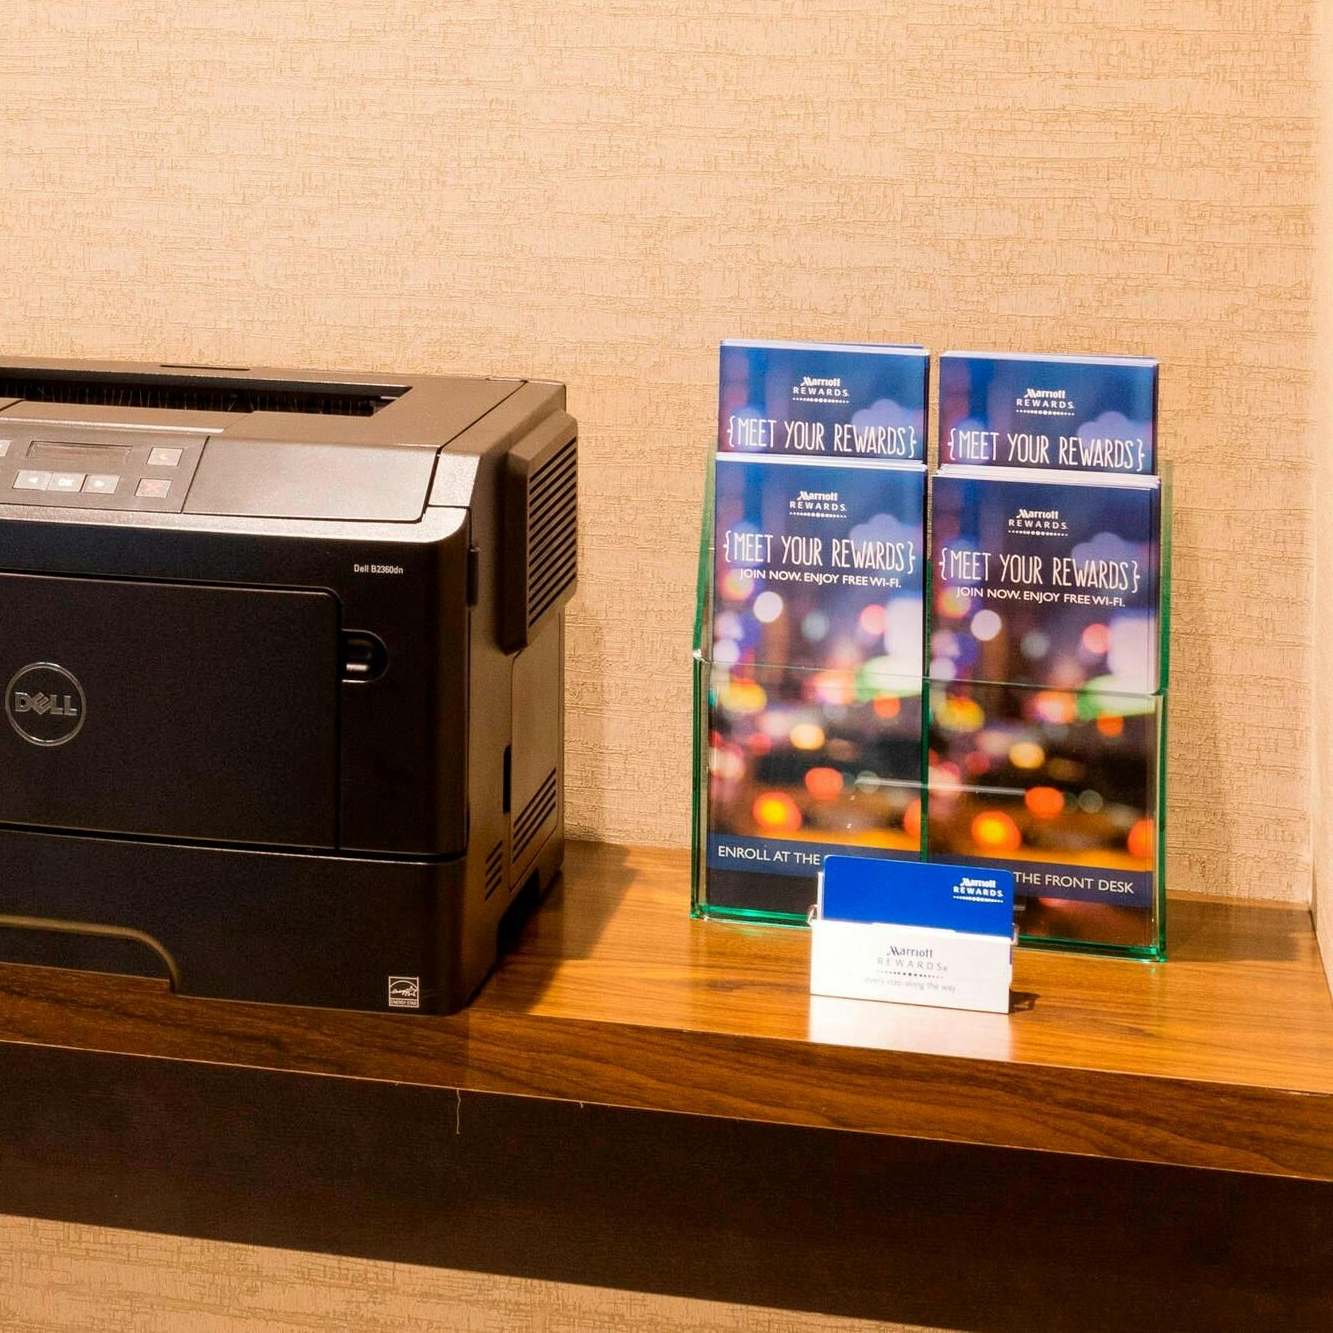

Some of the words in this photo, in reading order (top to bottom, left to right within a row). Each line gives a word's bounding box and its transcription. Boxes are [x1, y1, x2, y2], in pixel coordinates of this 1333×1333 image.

[800, 376, 841, 387] Marriott
[793, 386, 849, 397] REWARDS
[1024, 388, 1066, 399] Marriott
[1016, 398, 1075, 409] REWARDS
[784, 420, 825, 451] YOUR
[1007, 433, 1050, 464] YOUR
[58, 478, 73, 487] OK
[797, 490, 838, 501] Marriott
[789, 501, 847, 512] REWARDS
[1016, 509, 1059, 520] Marriott
[1008, 519, 1069, 530] REWARDS
[781, 535, 823, 566] YOUR
[353, 564, 369, 573] Dell
[999, 554, 1043, 585] YOUR
[740, 569, 766, 580] JOIN
[769, 570, 802, 581] NOW.
[804, 574, 839, 585] ENJOY
[843, 576, 870, 586] FREE
[870, 577, 902, 588] WI-FI.
[956, 587, 984, 598] JOIN
[987, 589, 1022, 600] NOW.
[1023, 592, 1060, 604] ENJOY
[1063, 594, 1091, 605] FREE
[1092, 595, 1126, 607] WI-FI.
[14, 691, 78, 716] DELL
[718, 845, 771, 861] ENROLL
[773, 851, 791, 862] AT
[793, 852, 821, 865] THE
[1013, 871, 1041, 885] THE
[1045, 874, 1094, 889] FRONT
[1098, 879, 1134, 894] DESK
[953, 886, 1004, 897] REWARDS
[886, 945, 933, 958] Marriott
